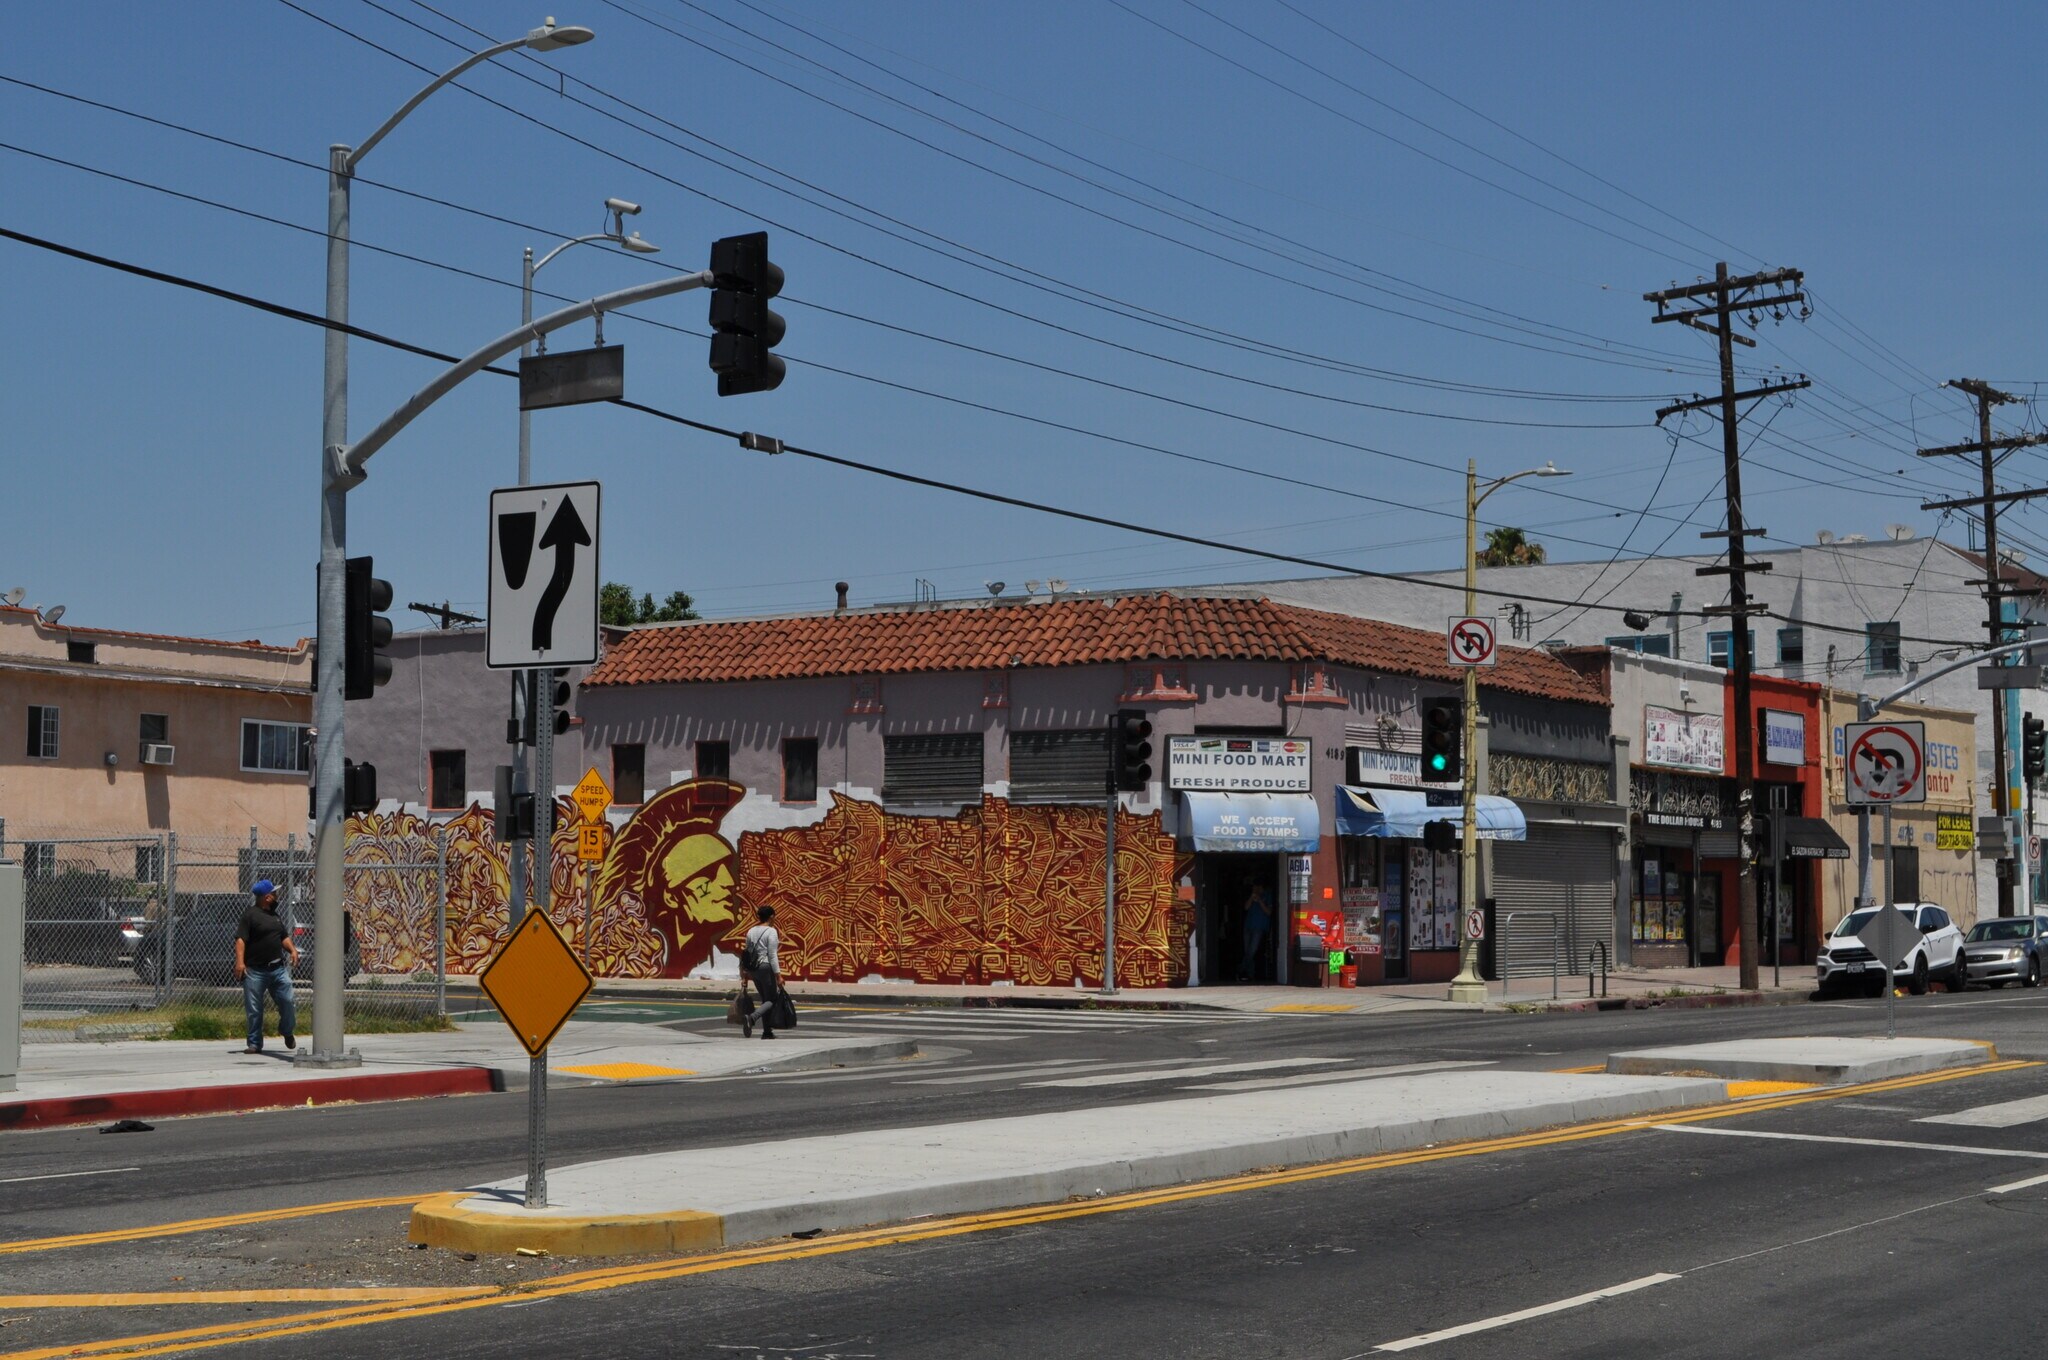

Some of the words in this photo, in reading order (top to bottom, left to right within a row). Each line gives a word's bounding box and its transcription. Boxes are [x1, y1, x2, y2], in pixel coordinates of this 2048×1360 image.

[1326, 747, 1345, 760] 4189
[1173, 754, 1208, 765] MINI
[1214, 754, 1257, 766] FOOD
[1262, 755, 1307, 767] MART
[1363, 752, 1378, 769] MINI
[1380, 754, 1398, 771] FOOD
[1400, 755, 1419, 773] MART
[1173, 778, 1225, 787] FRESH
[1231, 778, 1307, 788] PRODUCE
[1390, 773, 1413, 784] FRESH
[581, 785, 604, 795] SPEED
[580, 797, 604, 806] HUMPS
[1221, 815, 1239, 824] WE
[1249, 816, 1296, 826] ACCEPT
[1648, 814, 1660, 824] THE
[1661, 815, 1684, 826] DOLLAR
[1938, 815, 1951, 829] FOR
[1952, 816, 1971, 831] LEASE
[1213, 826, 1247, 836] FOOD
[1252, 827, 1299, 837] STAMPS
[583, 830, 598, 846] 15
[1237, 840, 1265, 850] 4189
[1289, 859, 1310, 872] AGUA
